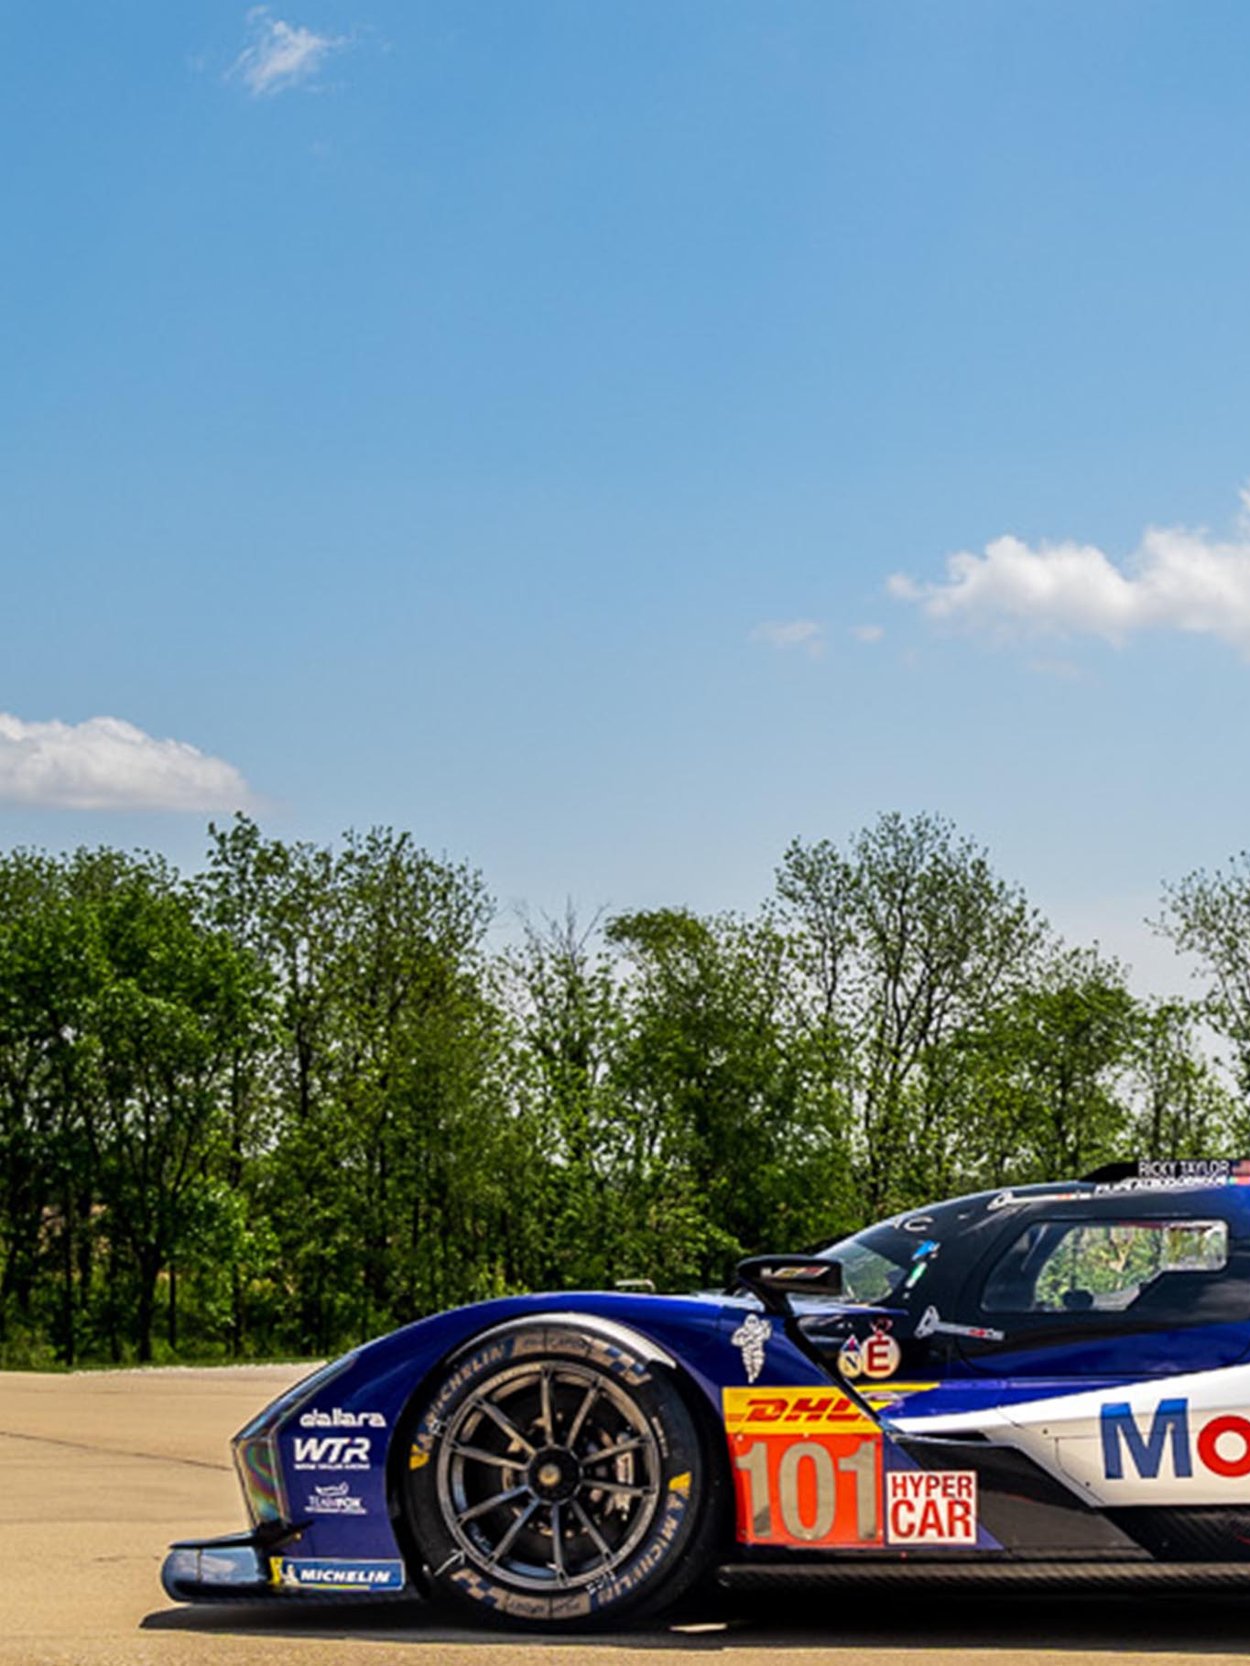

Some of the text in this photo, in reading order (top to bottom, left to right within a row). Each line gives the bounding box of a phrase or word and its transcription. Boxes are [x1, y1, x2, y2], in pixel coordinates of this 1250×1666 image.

[1139, 1161, 1229, 1176] RICKY TAYLOR
[300, 1407, 387, 1428] dallara
[746, 1398, 861, 1422] DHL
[294, 1437, 371, 1463] WTR
[735, 1441, 877, 1541] 101
[892, 1475, 972, 1498] HYPER
[891, 1499, 972, 1538] CAR
[301, 1569, 391, 1583] MICHELIN
